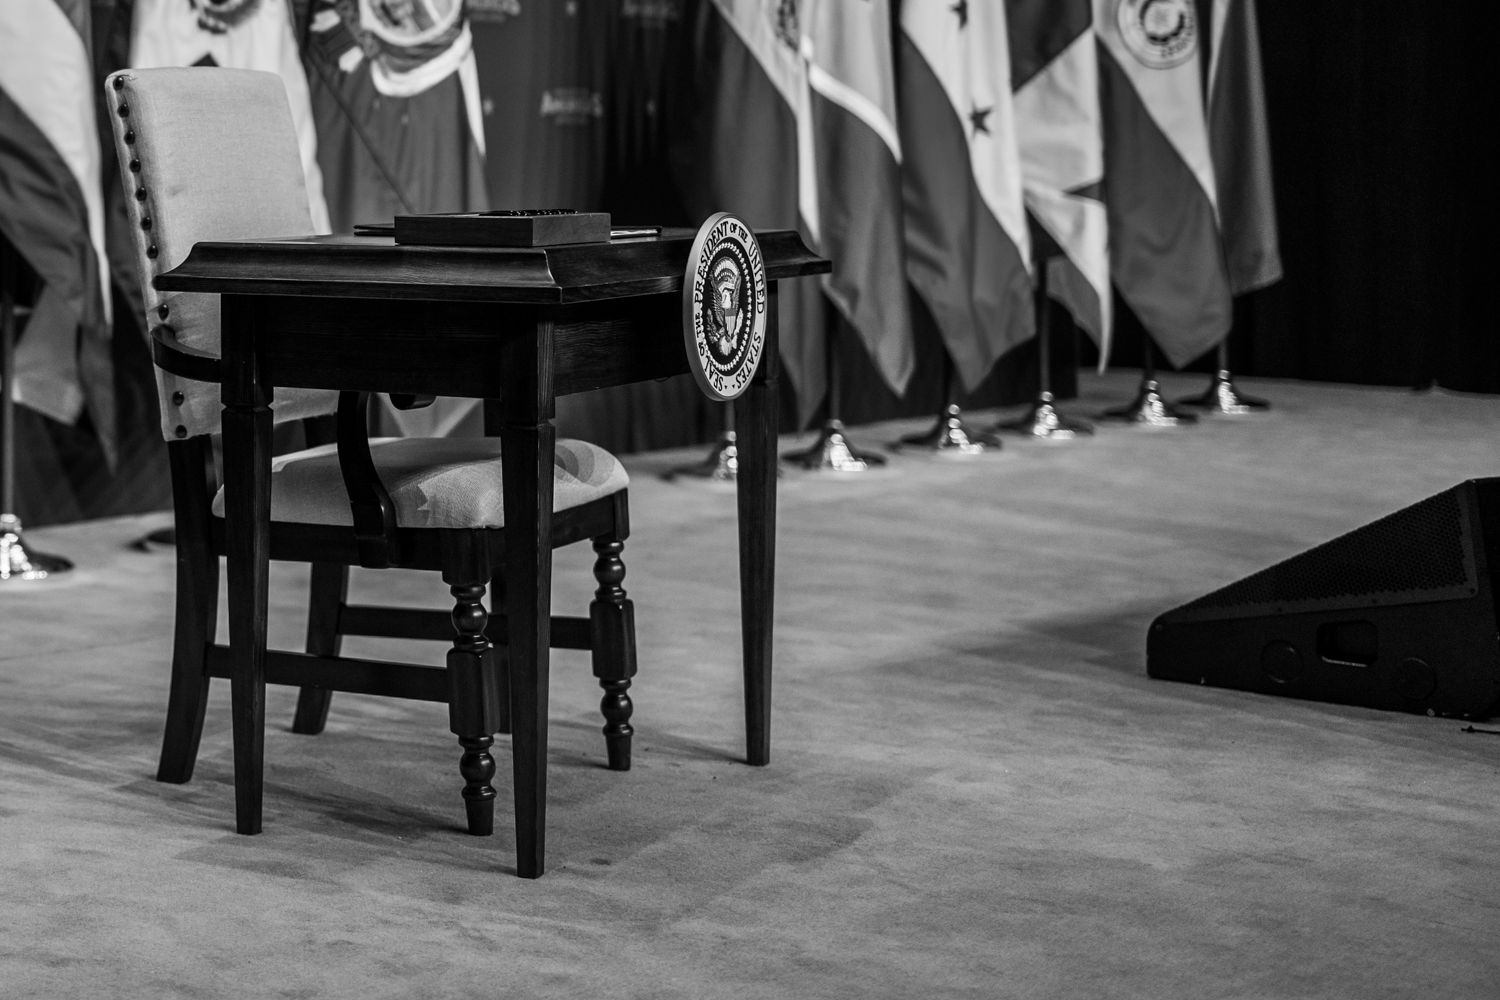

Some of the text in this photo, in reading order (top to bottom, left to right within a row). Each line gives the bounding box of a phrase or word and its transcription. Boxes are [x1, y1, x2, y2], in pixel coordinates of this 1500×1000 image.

[729, 222, 738, 234] OF
[738, 226, 748, 244] THE
[694, 220, 728, 303] PRESIDENT
[748, 241, 764, 314] UNITED
[698, 341, 706, 357] OF
[735, 331, 762, 390] STATES
[704, 355, 724, 392] SEAL
